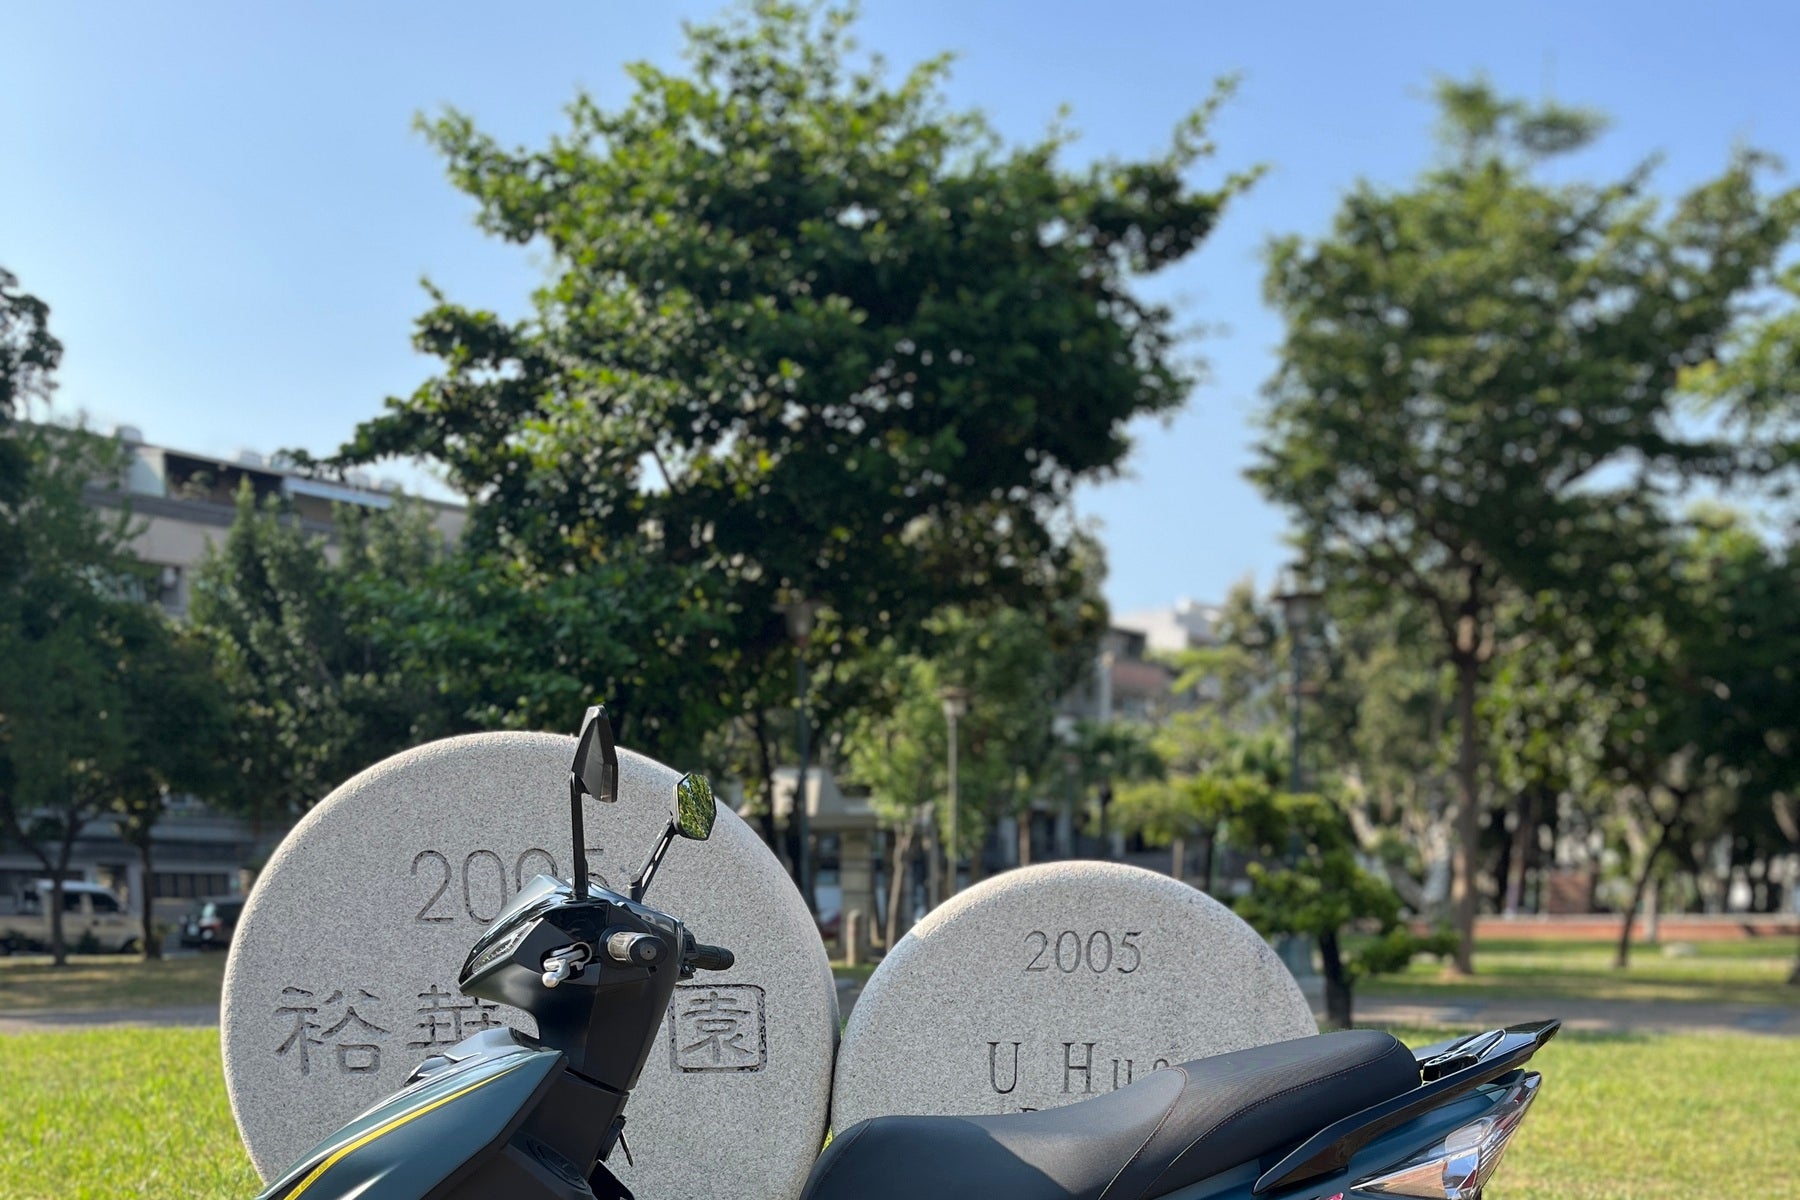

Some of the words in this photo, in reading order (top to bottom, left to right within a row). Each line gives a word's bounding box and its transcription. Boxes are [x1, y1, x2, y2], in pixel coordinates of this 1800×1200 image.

[1023, 930, 1142, 974] 2005
[987, 1041, 1022, 1094] U
[1060, 1042, 1169, 1094] Hu
